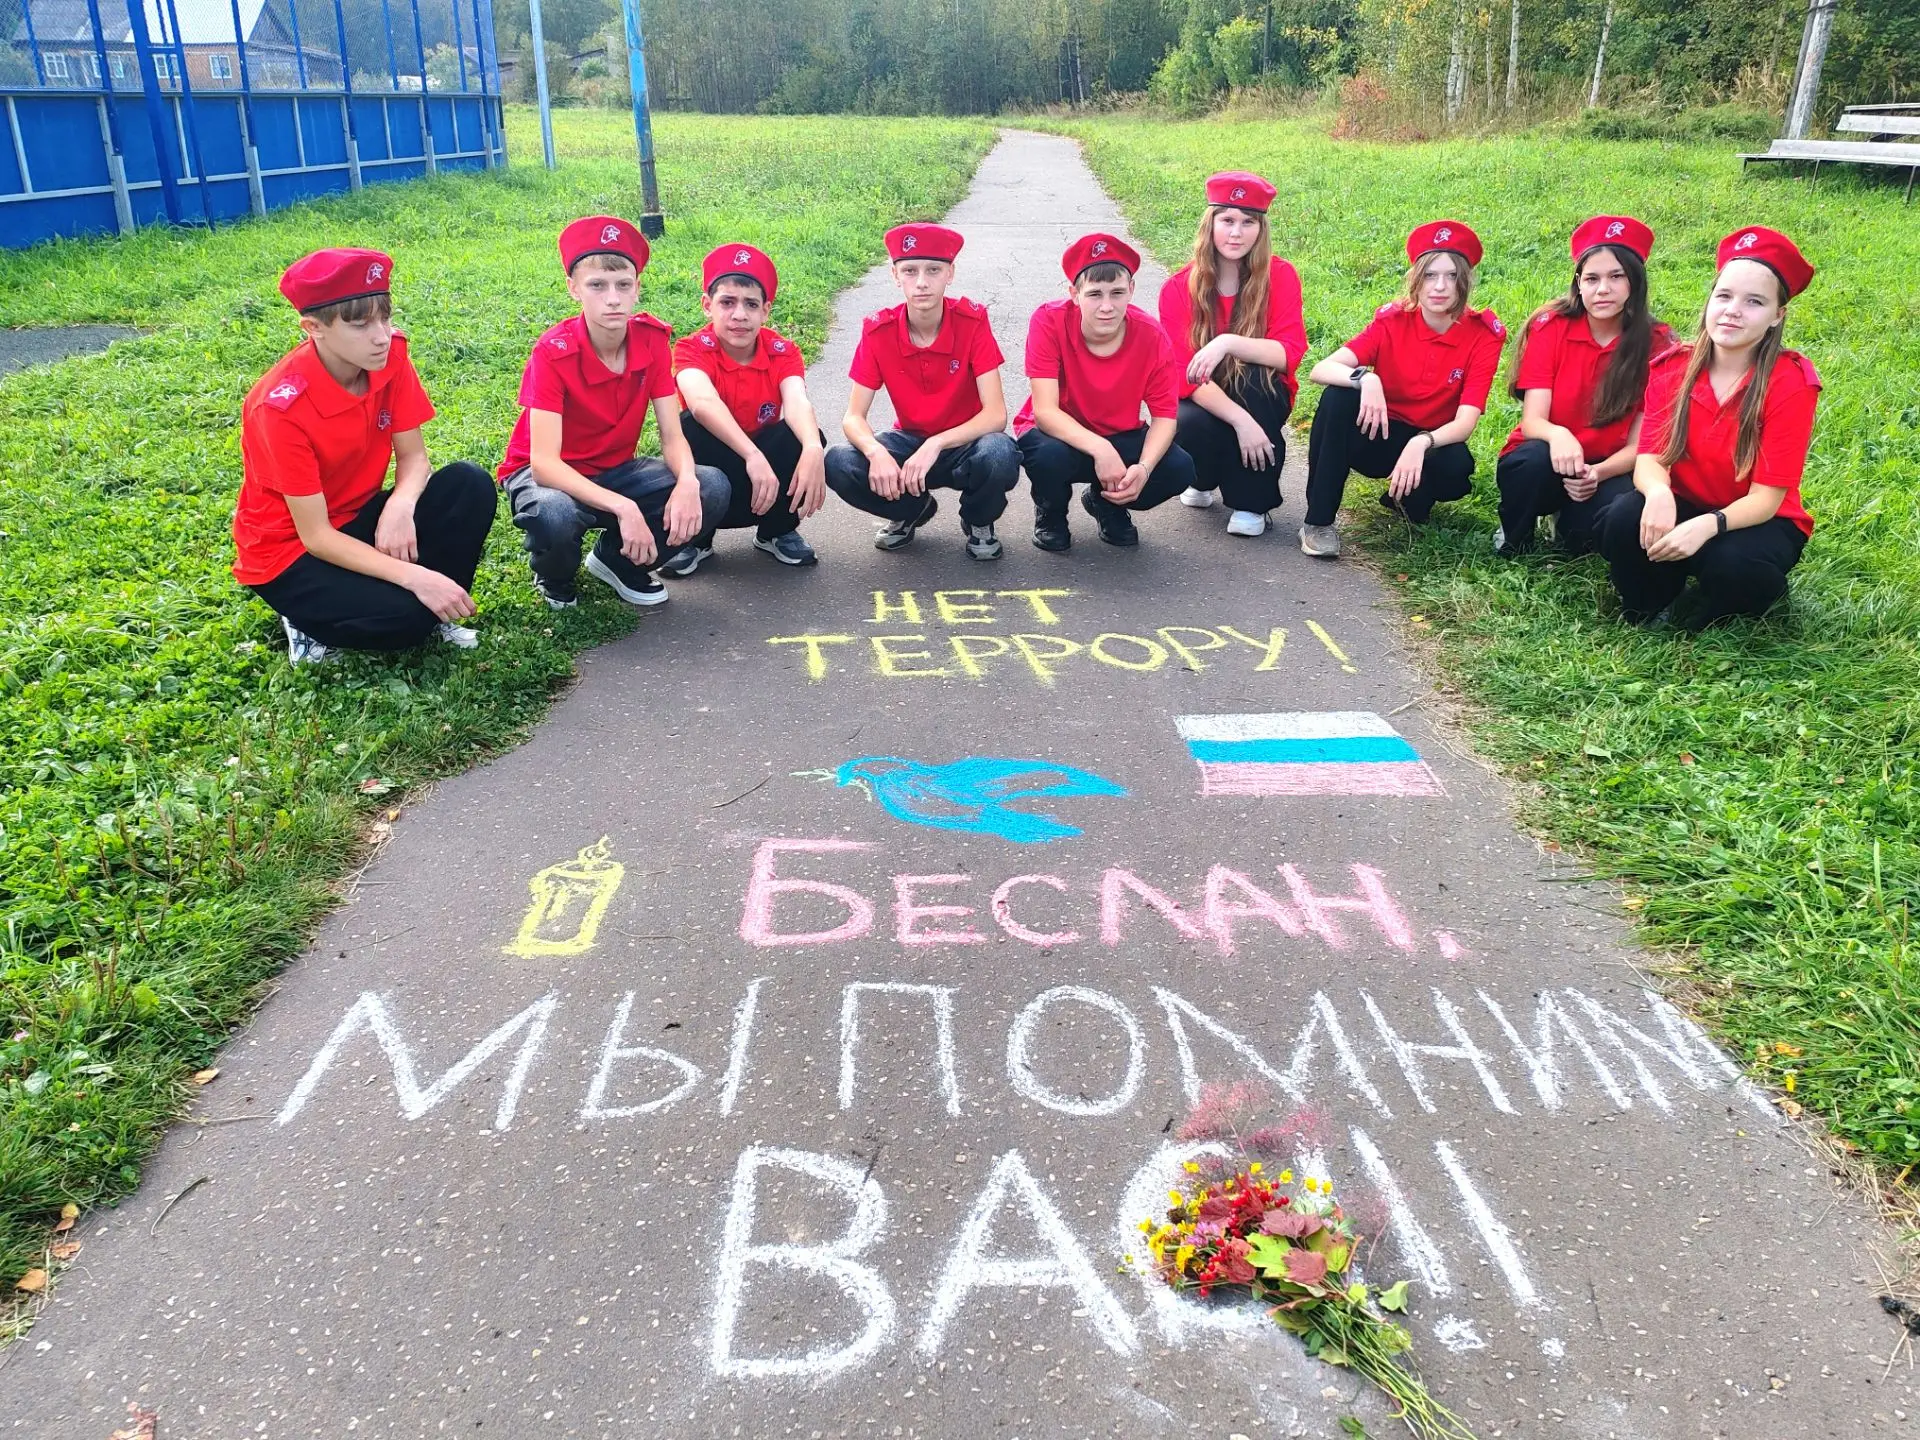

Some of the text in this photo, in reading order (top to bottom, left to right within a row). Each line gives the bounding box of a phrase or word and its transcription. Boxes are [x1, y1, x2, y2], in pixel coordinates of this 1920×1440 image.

[869, 588, 1076, 625] НЕТ
[766, 619, 1358, 686] ТЕРРОРУ!
[274, 976, 1784, 1132] МЫ ПОМНИМ
